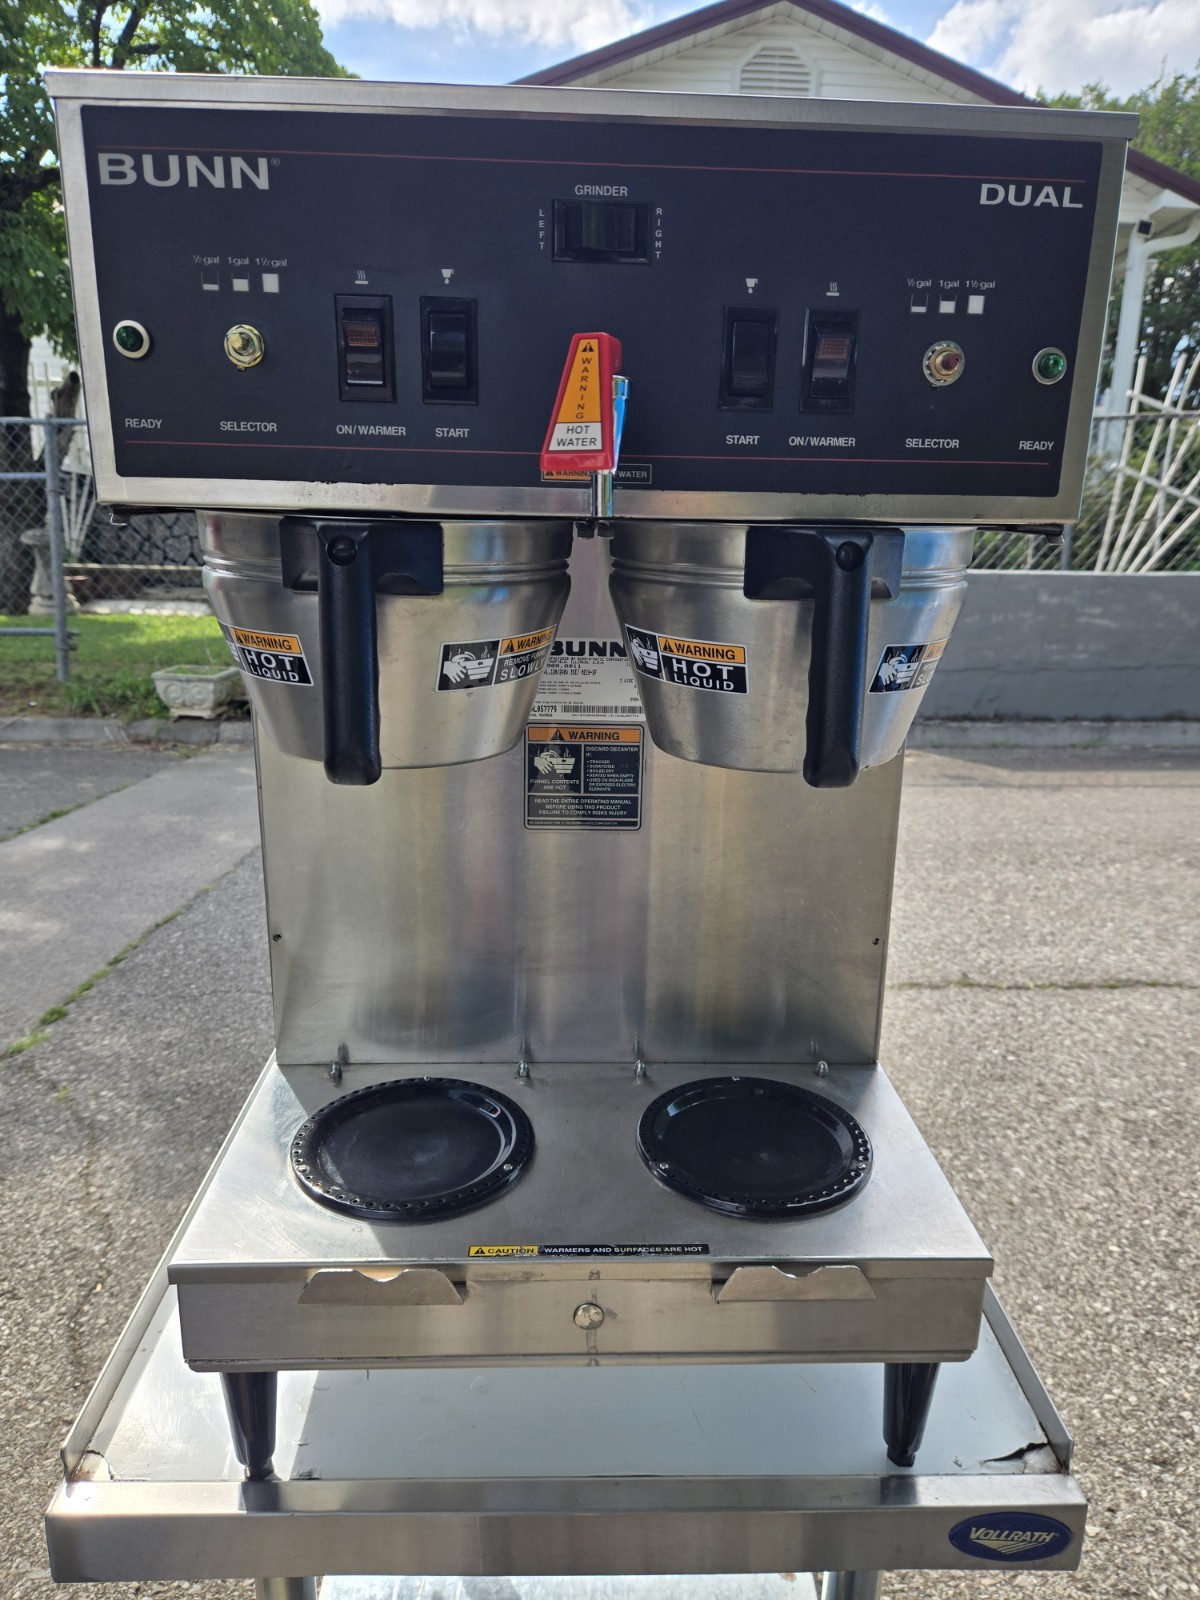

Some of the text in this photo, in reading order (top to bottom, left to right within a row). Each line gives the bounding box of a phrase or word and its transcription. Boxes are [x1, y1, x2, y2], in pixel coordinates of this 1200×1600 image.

[98, 153, 269, 190] BUNN
[575, 185, 628, 197] GRINDER
[980, 183, 1083, 208] DUAL
[655, 207, 663, 259] RIGHT
[576, 357, 592, 420] WARNING
[125, 418, 163, 429] READY
[220, 421, 277, 432] SELECTOR
[336, 425, 406, 436] ON/WARMER
[435, 427, 470, 438] START
[567, 425, 591, 435] HOT
[557, 438, 597, 447] WATER
[726, 435, 760, 445] START
[788, 436, 856, 447] ON/WARMER
[905, 438, 960, 449] SELECTOR
[1019, 440, 1054, 451] READY
[618, 470, 648, 478] WATER
[241, 633, 292, 651] WARNING
[550, 640, 628, 657] BUNN
[674, 642, 736, 661] WARNING
[244, 649, 294, 671] HOT
[250, 665, 299, 682] LIQUID
[672, 658, 734, 680] HOT
[674, 673, 735, 691] LIQUID
[568, 731, 620, 741] WARNING
[970, 1527, 1056, 1543] VOLLRATH
